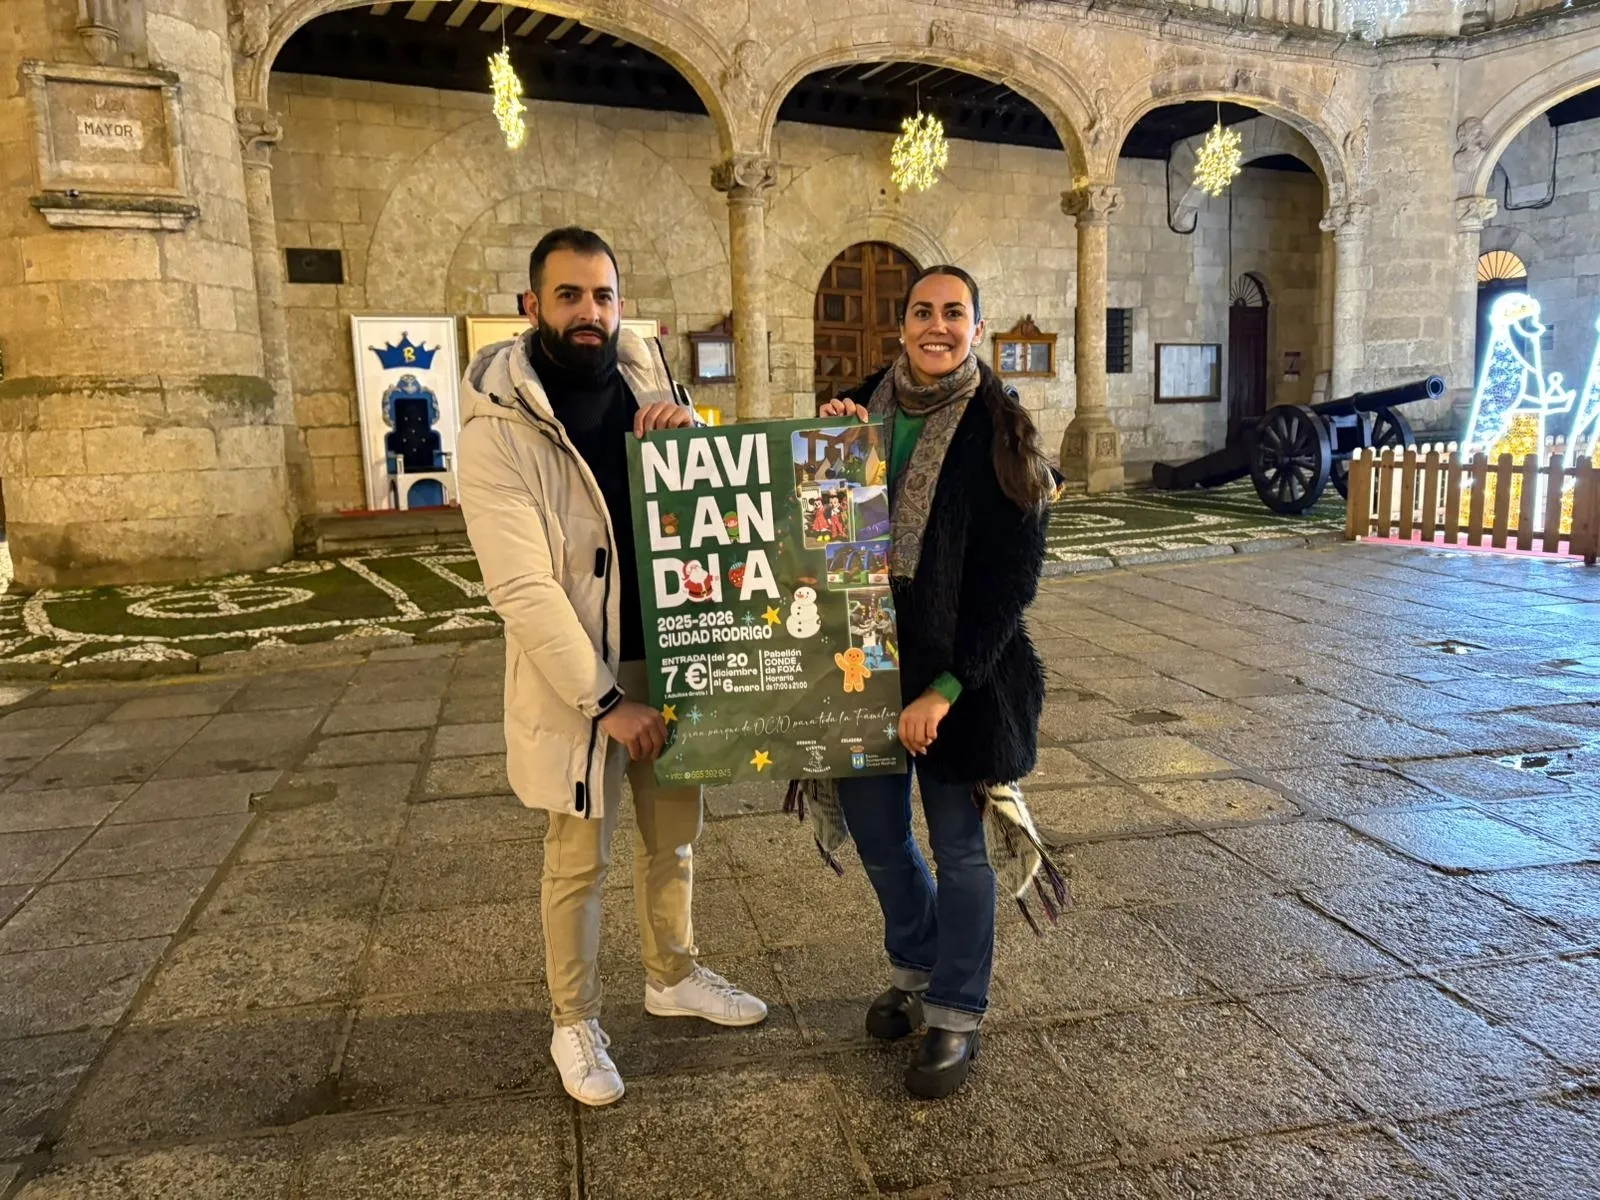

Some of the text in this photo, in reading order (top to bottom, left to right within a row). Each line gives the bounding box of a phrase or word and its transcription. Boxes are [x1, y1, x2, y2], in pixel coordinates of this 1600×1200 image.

[84, 121, 133, 137] MAYOR
[403, 346, 416, 363] B
[641, 432, 771, 493] NAVI
[657, 610, 734, 632] 2025-2026
[659, 624, 773, 648] CIUDAD RODRIGO
[662, 654, 706, 666] ENTRADA
[711, 652, 748, 668] del 20
[763, 649, 802, 658] Pabellón
[764, 657, 797, 666] CONDE
[713, 668, 758, 678] diciembre
[765, 663, 803, 674] de FOXÁ
[661, 662, 708, 693] 7 €
[713, 678, 760, 693] al 6 enero
[766, 674, 794, 682] Horario
[707, 727, 738, 741] parque
[754, 714, 791, 736] OCIO
[792, 719, 816, 729] para
[839, 711, 850, 725] la
[852, 706, 899, 726] Familia
